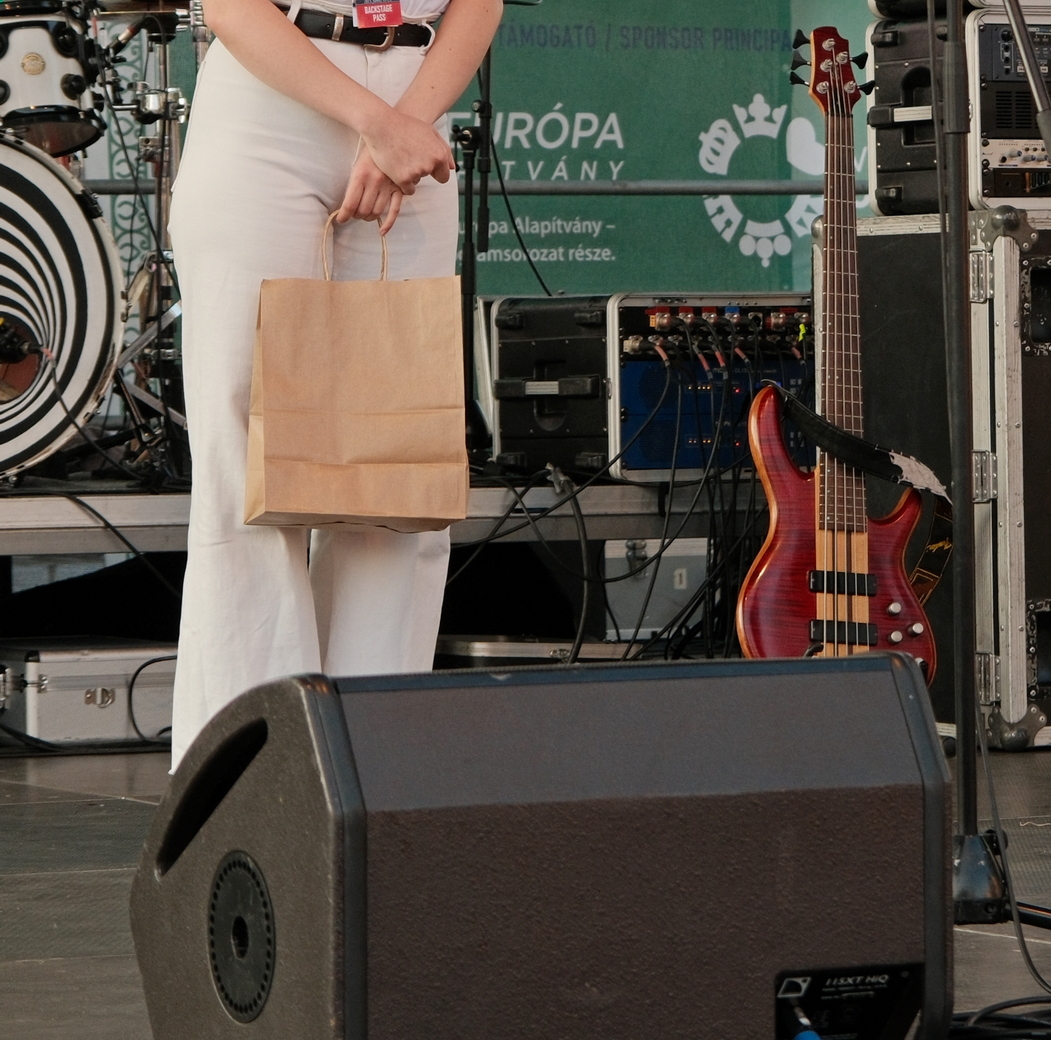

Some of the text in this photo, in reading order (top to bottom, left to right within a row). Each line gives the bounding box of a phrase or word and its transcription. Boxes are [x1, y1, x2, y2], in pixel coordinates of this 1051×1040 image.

[364, 4, 393, 14] BACKSTAGE
[372, 13, 387, 22] PASS
[618, 25, 705, 50] SPONSOR
[712, 26, 793, 52] PRINCIPA
[512, 216, 602, 238] Alapítvány
[568, 245, 616, 262] része.
